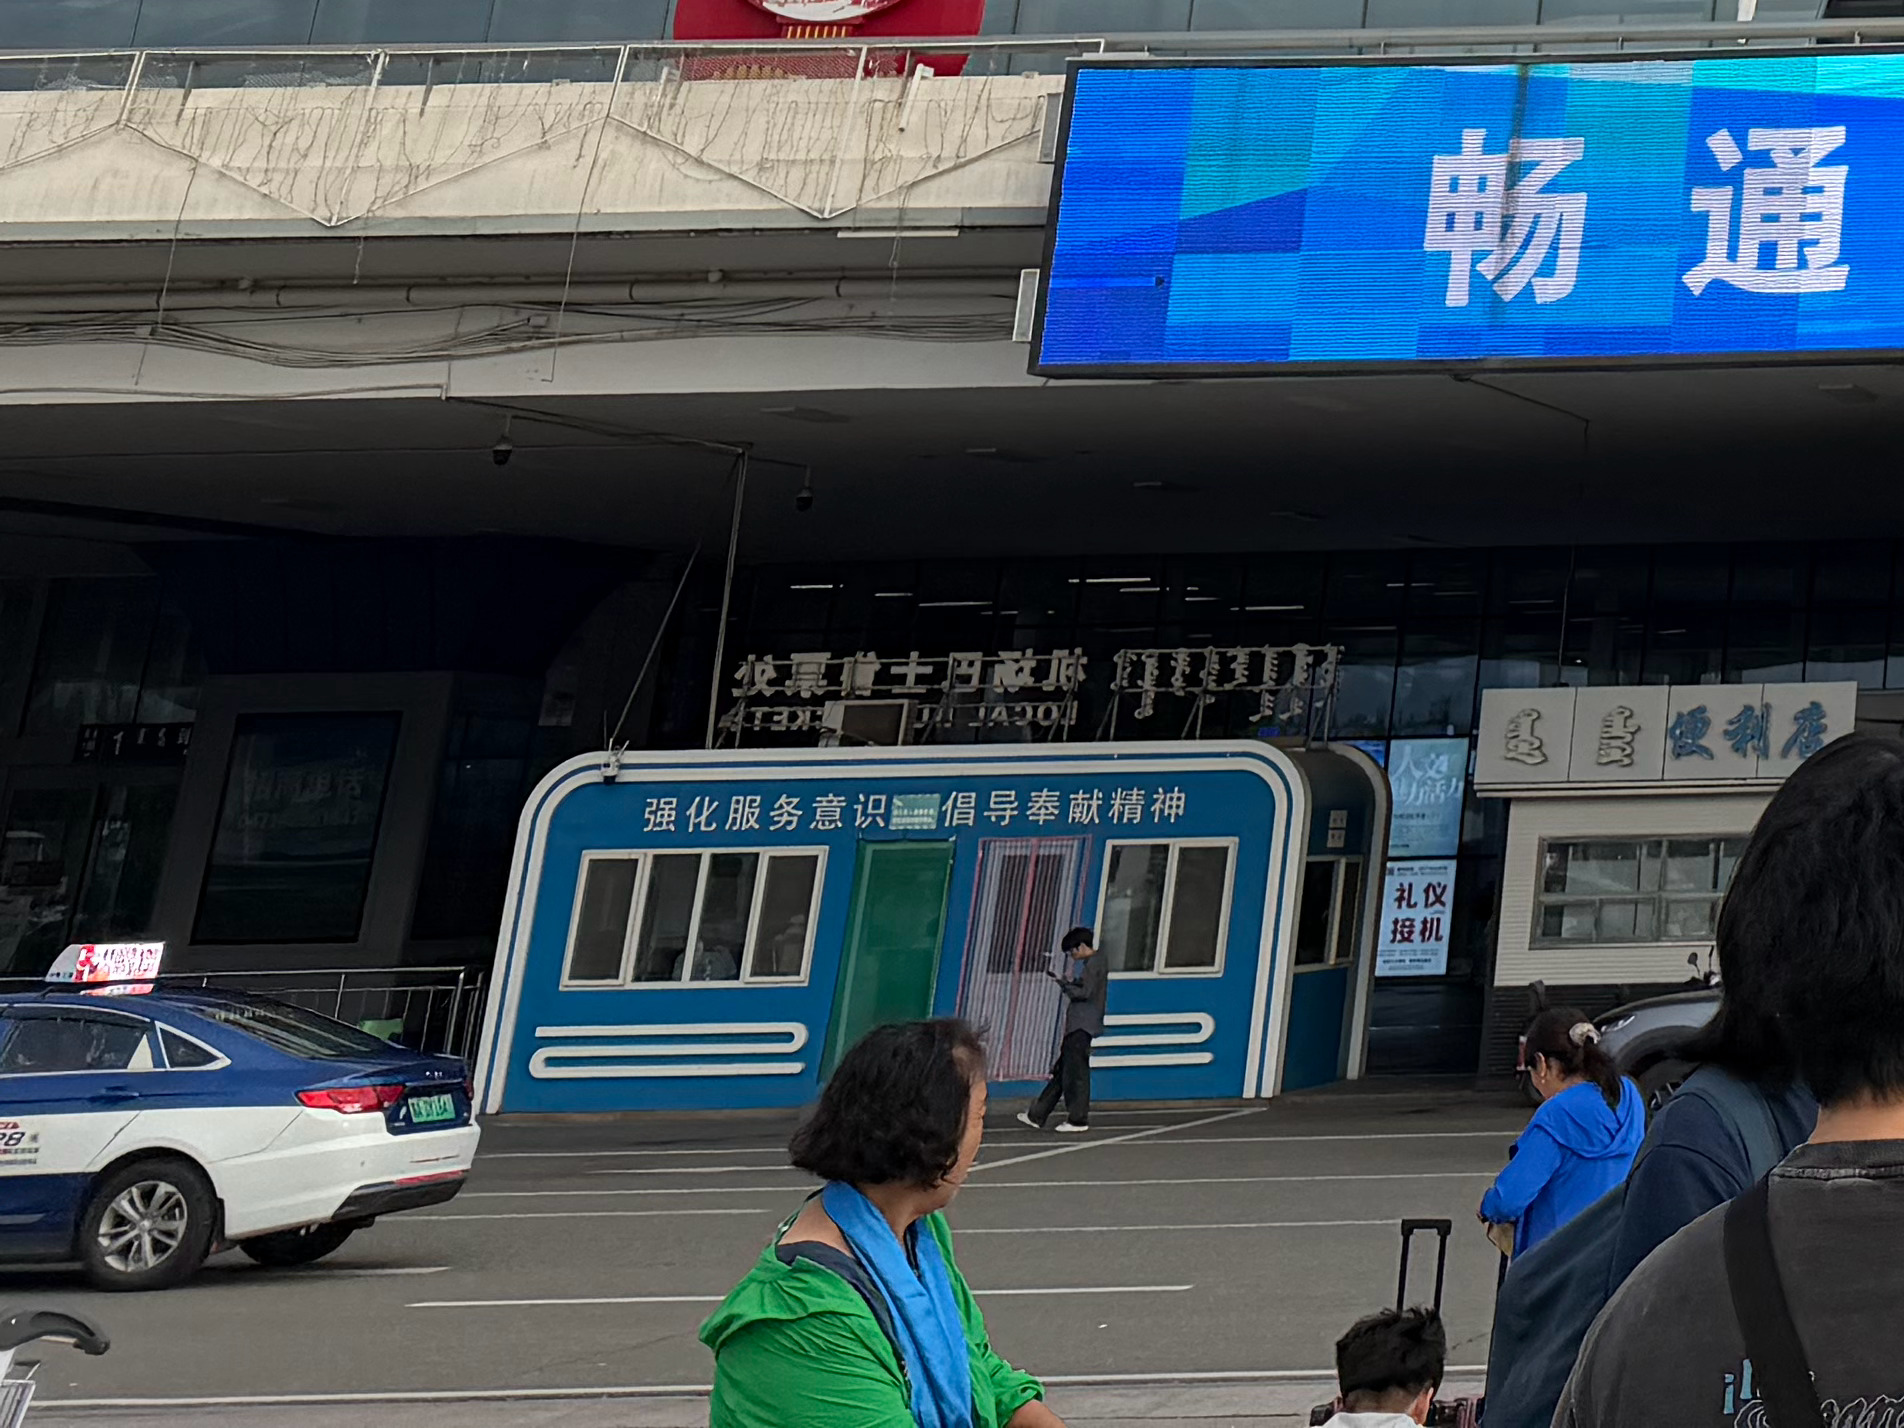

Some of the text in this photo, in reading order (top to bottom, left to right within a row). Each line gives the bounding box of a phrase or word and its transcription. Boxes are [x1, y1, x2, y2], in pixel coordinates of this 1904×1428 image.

[1668, 700, 1829, 762] 便利店
[642, 792, 887, 834] 强化服务意识
[941, 785, 1187, 828] 倡导奉献精神
[1394, 882, 1448, 909] 礼仪
[1390, 917, 1444, 943] 接机
